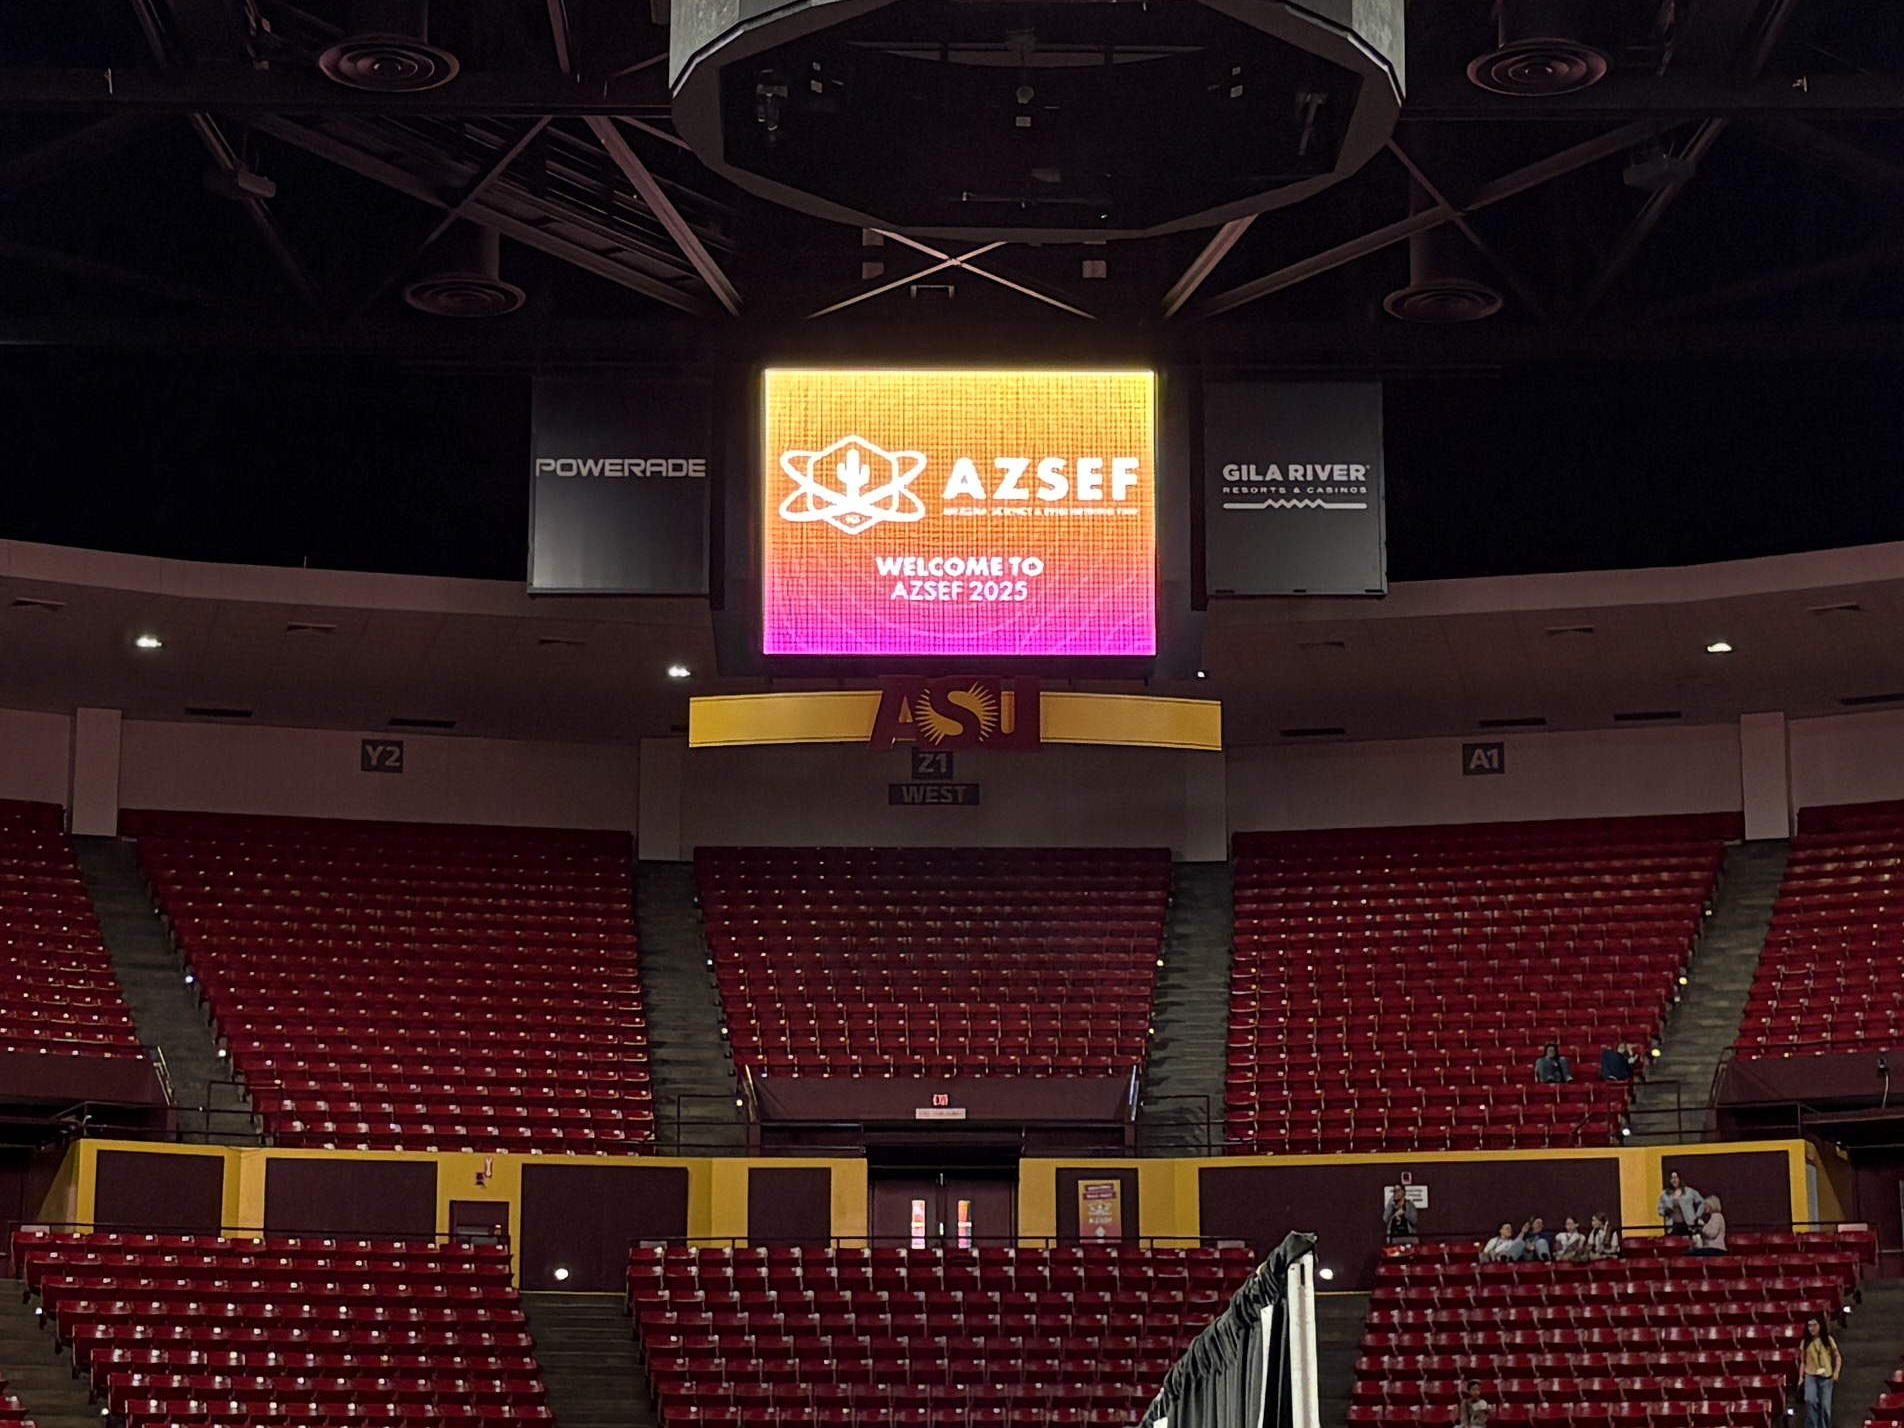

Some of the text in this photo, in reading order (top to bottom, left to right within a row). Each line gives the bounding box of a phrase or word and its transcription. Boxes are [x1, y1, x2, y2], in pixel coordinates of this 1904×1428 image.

[535, 458, 706, 478] POWERADE
[1222, 464, 1367, 481] GILA RIVER
[942, 457, 1140, 501] AZSEF
[1223, 486, 1286, 494] RESORTS
[1307, 486, 1367, 494] CASINOS
[876, 556, 1045, 577] WELCOME TO
[890, 581, 1028, 602] AZSEF 2025
[868, 675, 1041, 753] ASU
[365, 745, 401, 767] Y2
[919, 753, 947, 773] Z1
[1470, 748, 1500, 769] A1
[902, 786, 967, 803] WEST
